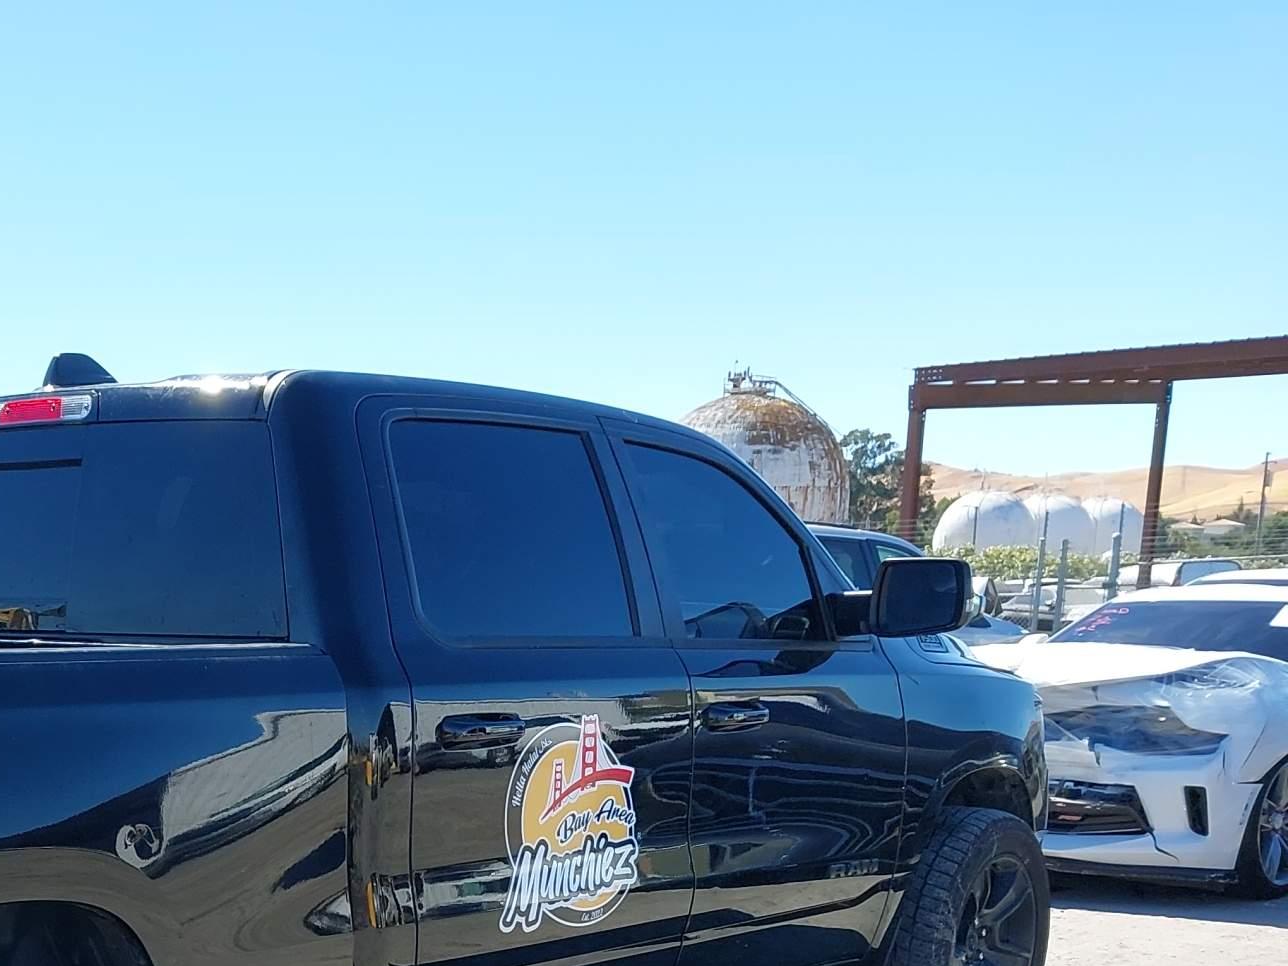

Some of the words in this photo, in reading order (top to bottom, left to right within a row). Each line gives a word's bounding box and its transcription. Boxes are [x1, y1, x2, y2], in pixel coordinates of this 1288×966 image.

[556, 811, 592, 842] Bay
[595, 798, 635, 825] Area
[501, 834, 637, 928] Munchiez
